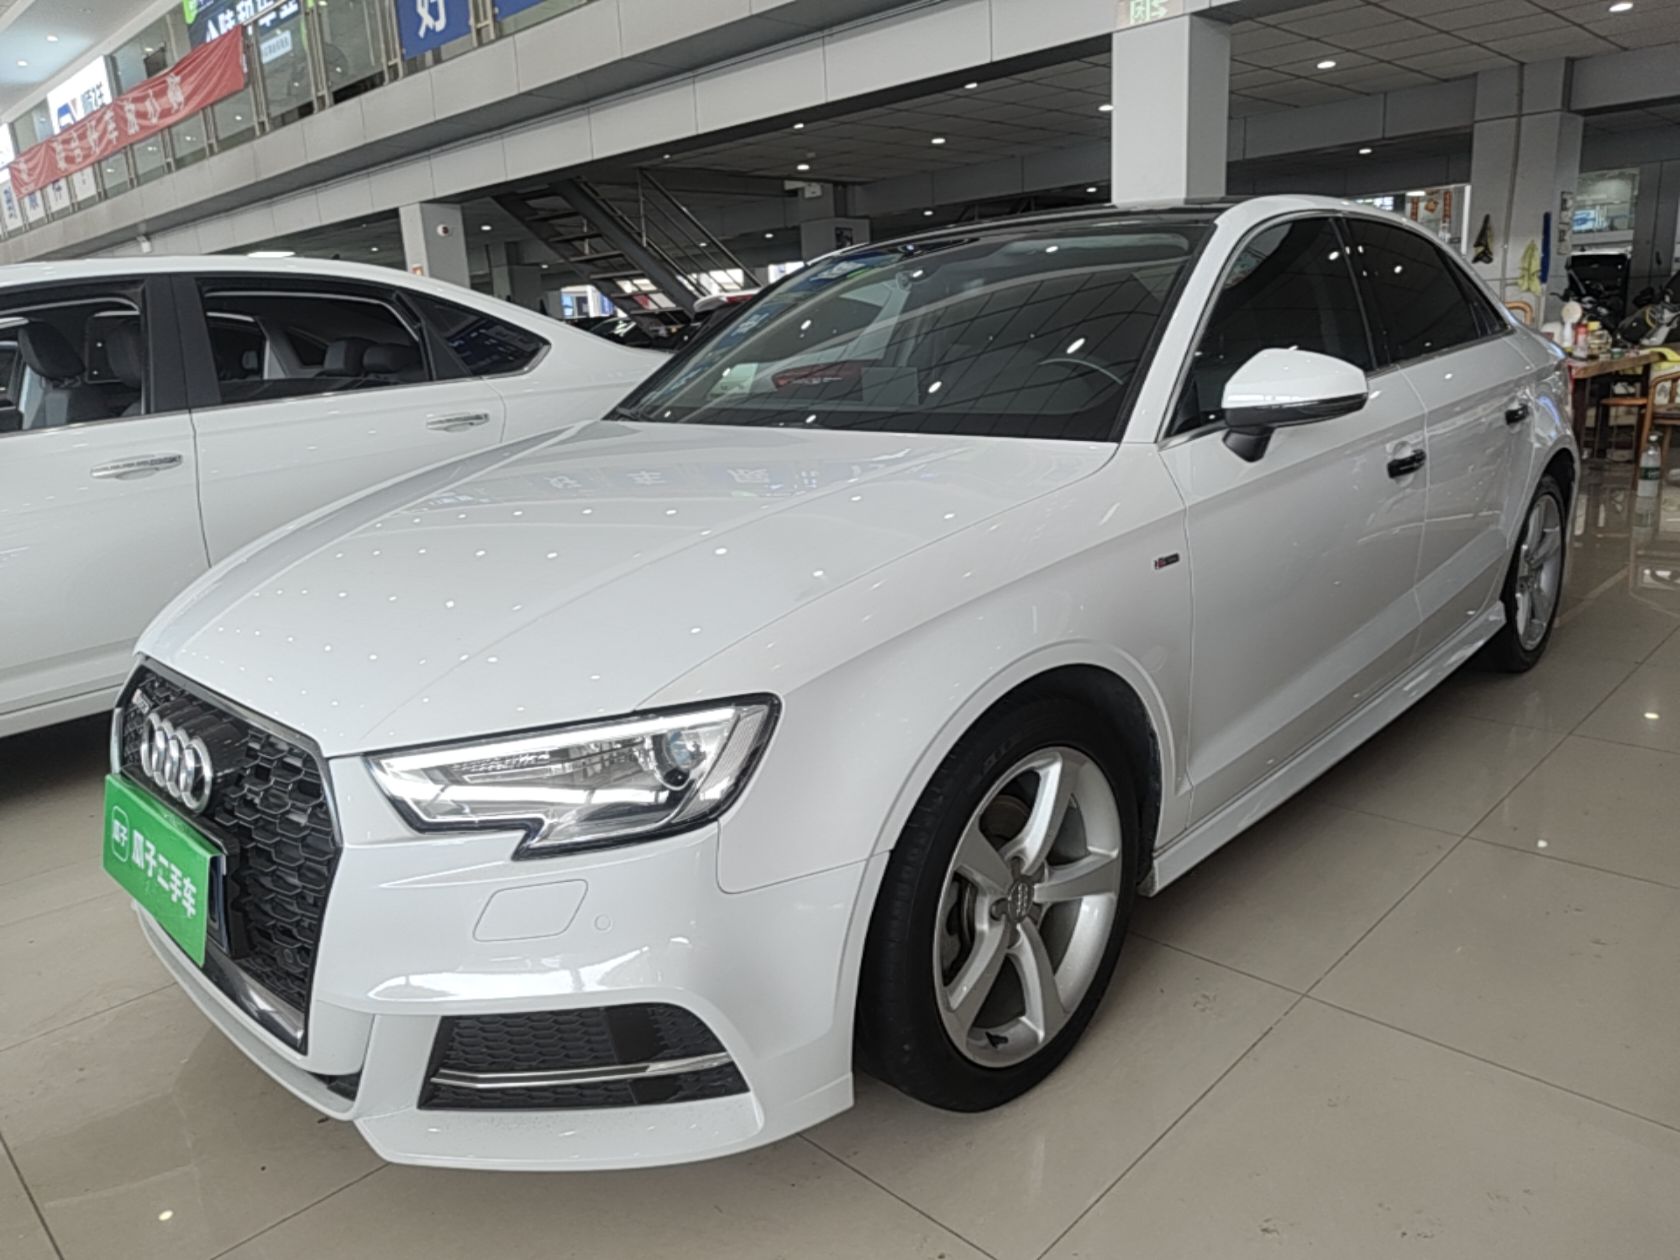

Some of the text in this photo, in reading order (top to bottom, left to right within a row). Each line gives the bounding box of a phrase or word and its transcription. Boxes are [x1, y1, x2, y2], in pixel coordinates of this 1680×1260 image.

[132, 829, 197, 919] 瓜子二手车
